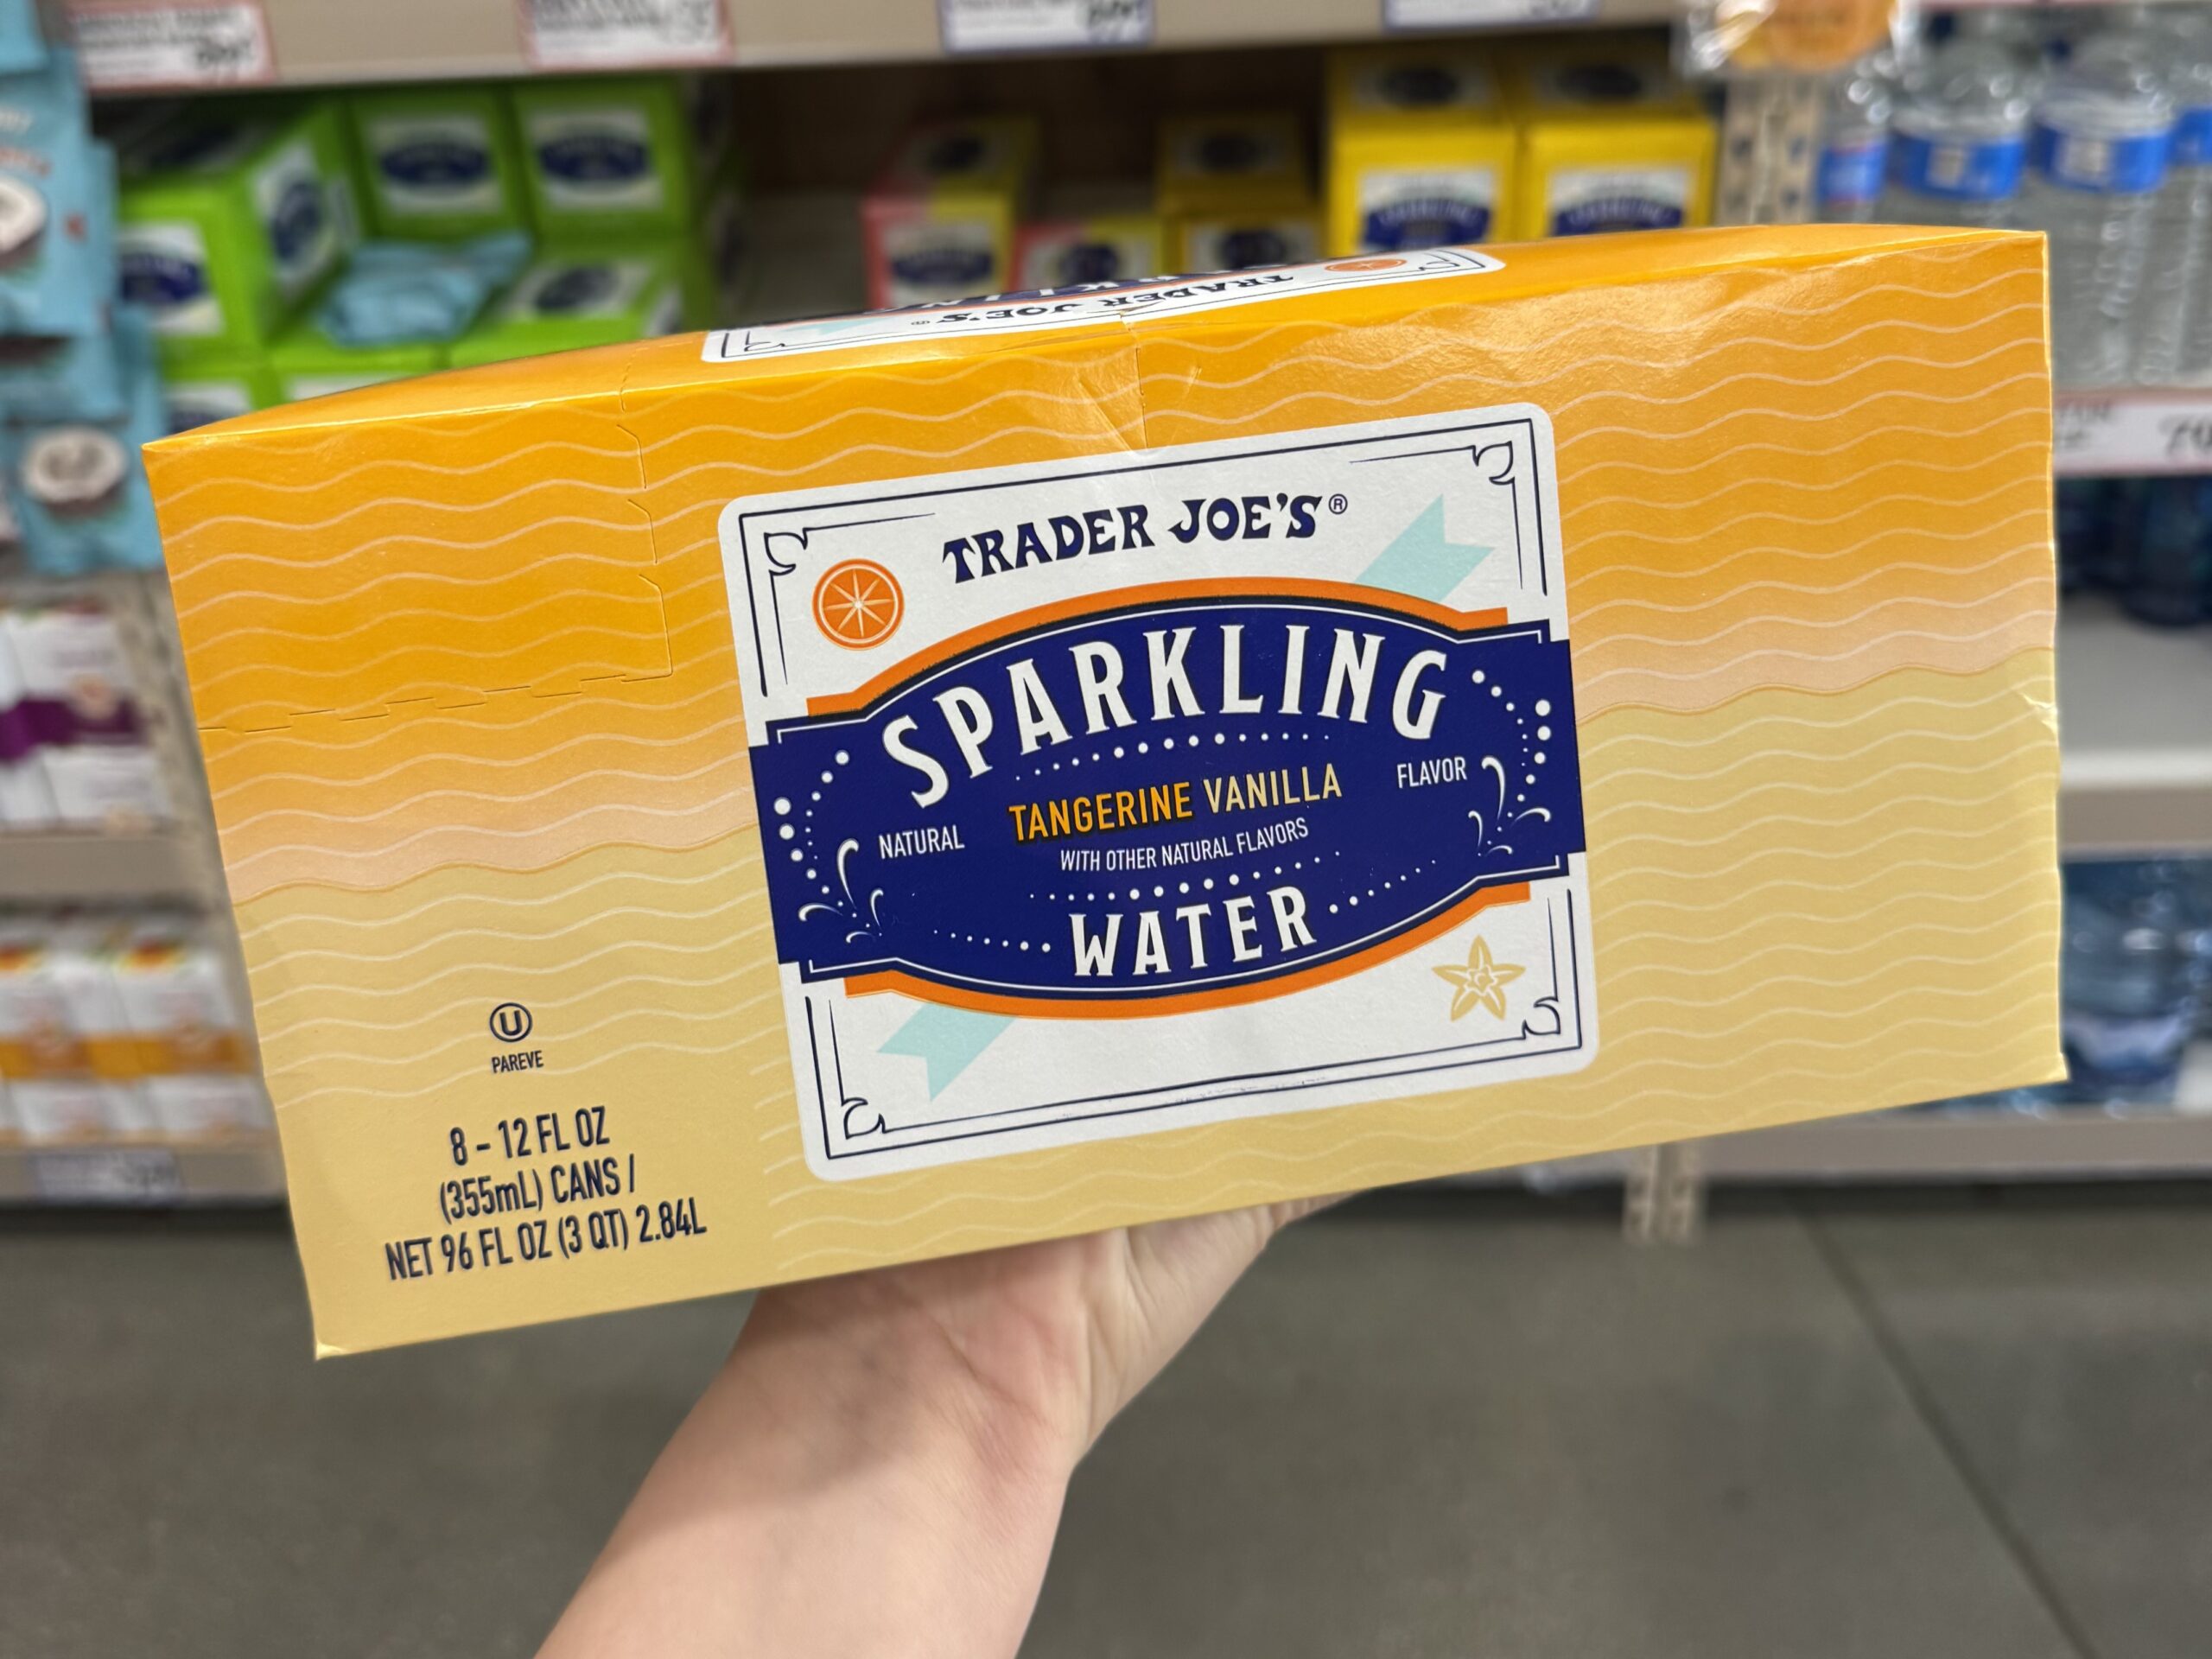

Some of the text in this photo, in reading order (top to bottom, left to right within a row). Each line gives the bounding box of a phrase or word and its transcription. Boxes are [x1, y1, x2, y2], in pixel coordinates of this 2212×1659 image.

[1102, 274, 1294, 308] TRADER
[942, 504, 1154, 583] TRADER
[882, 624, 1447, 809] SPARKLING
[1009, 763, 1343, 841] TANGERINE VANILLA
[1396, 757, 1467, 788] FLAVOR
[879, 824, 965, 859] NATURAL
[1060, 817, 1309, 872] WITH OTHER NATURAL FLAVORS
[1068, 887, 1317, 976] WATER
[492, 1050, 544, 1074] PAREVE
[449, 1126, 469, 1166] 8
[498, 1117, 532, 1159] 12
[536, 1112, 570, 1154] FL
[575, 1105, 611, 1147] OZ
[439, 1168, 544, 1225] (355mL)
[550, 1156, 621, 1204] CANS
[385, 1197, 708, 1281] NET 96 FL OZ (3 QT) 2.84L
